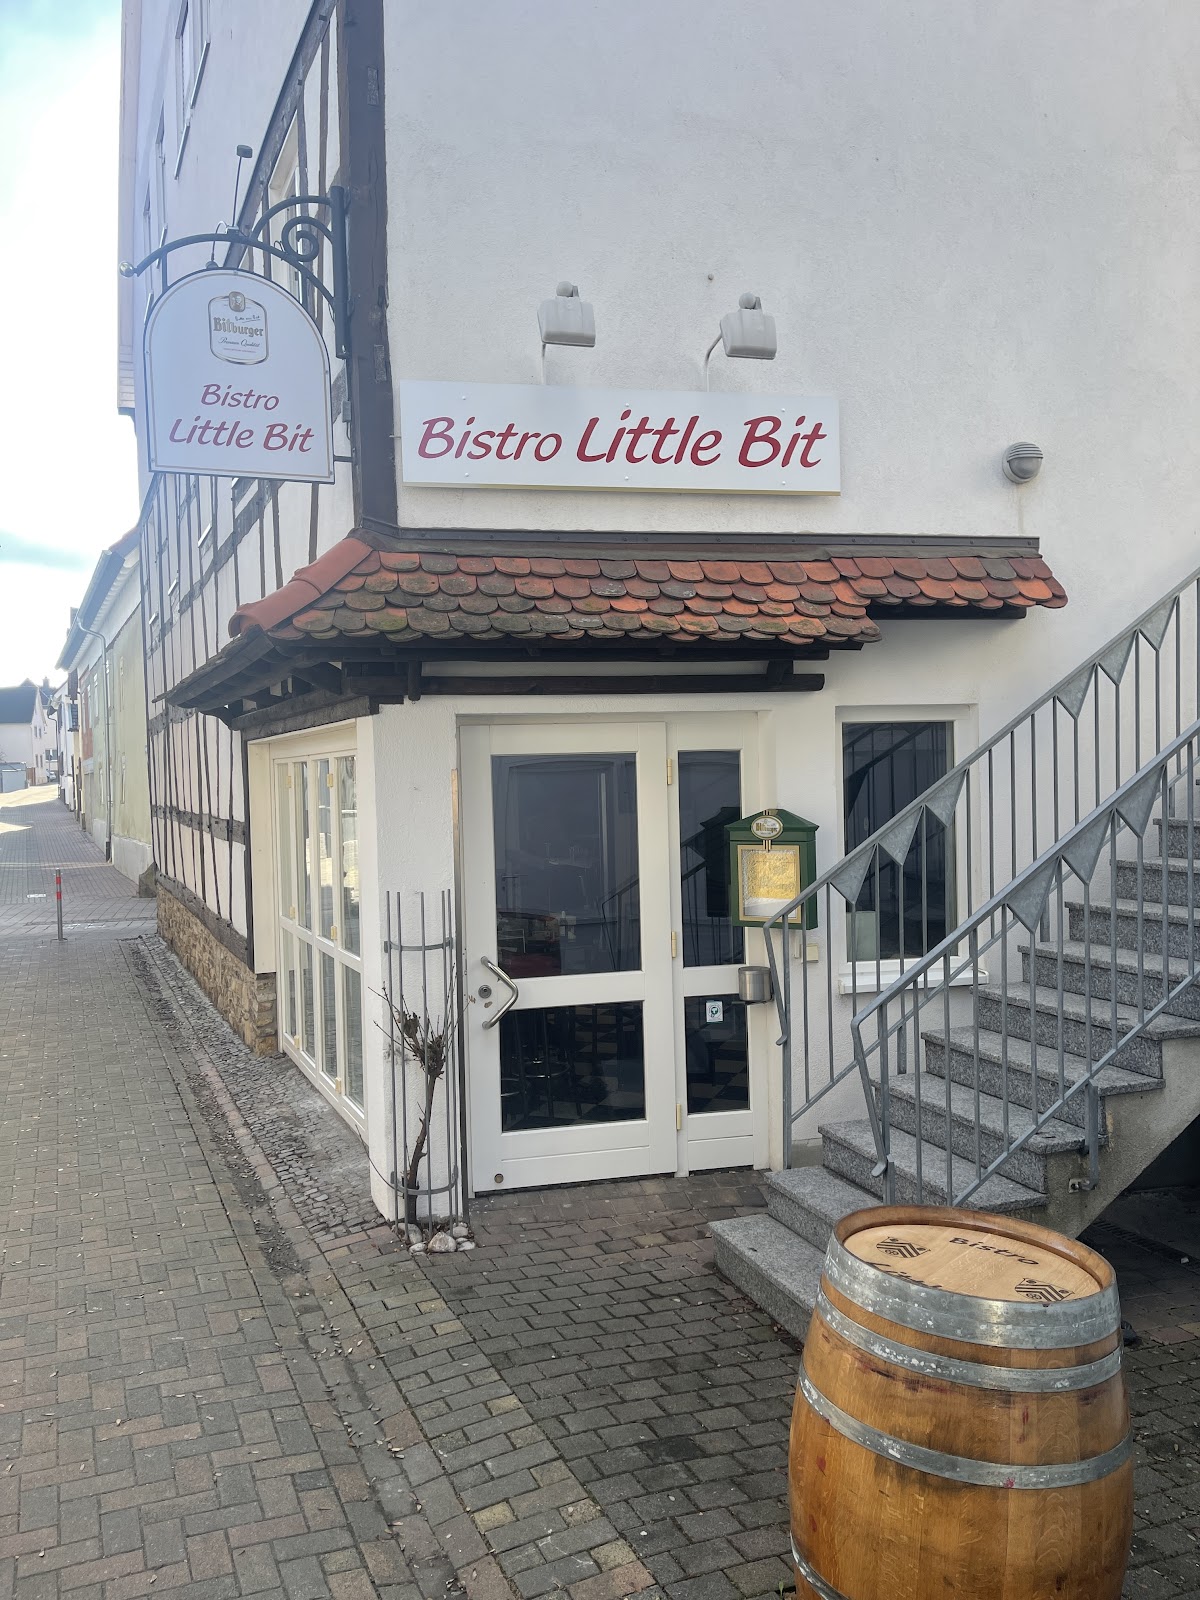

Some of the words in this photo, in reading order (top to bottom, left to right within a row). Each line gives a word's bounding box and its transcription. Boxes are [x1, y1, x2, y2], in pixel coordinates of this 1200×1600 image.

[213, 316, 264, 337] Bitburger
[201, 384, 279, 410] Bistro
[169, 416, 254, 448] Little
[263, 423, 314, 452] Bit
[417, 416, 562, 462] Bistro
[576, 409, 722, 467] Little
[738, 415, 827, 468] Bit
[949, 1237, 1039, 1265] Bistro
